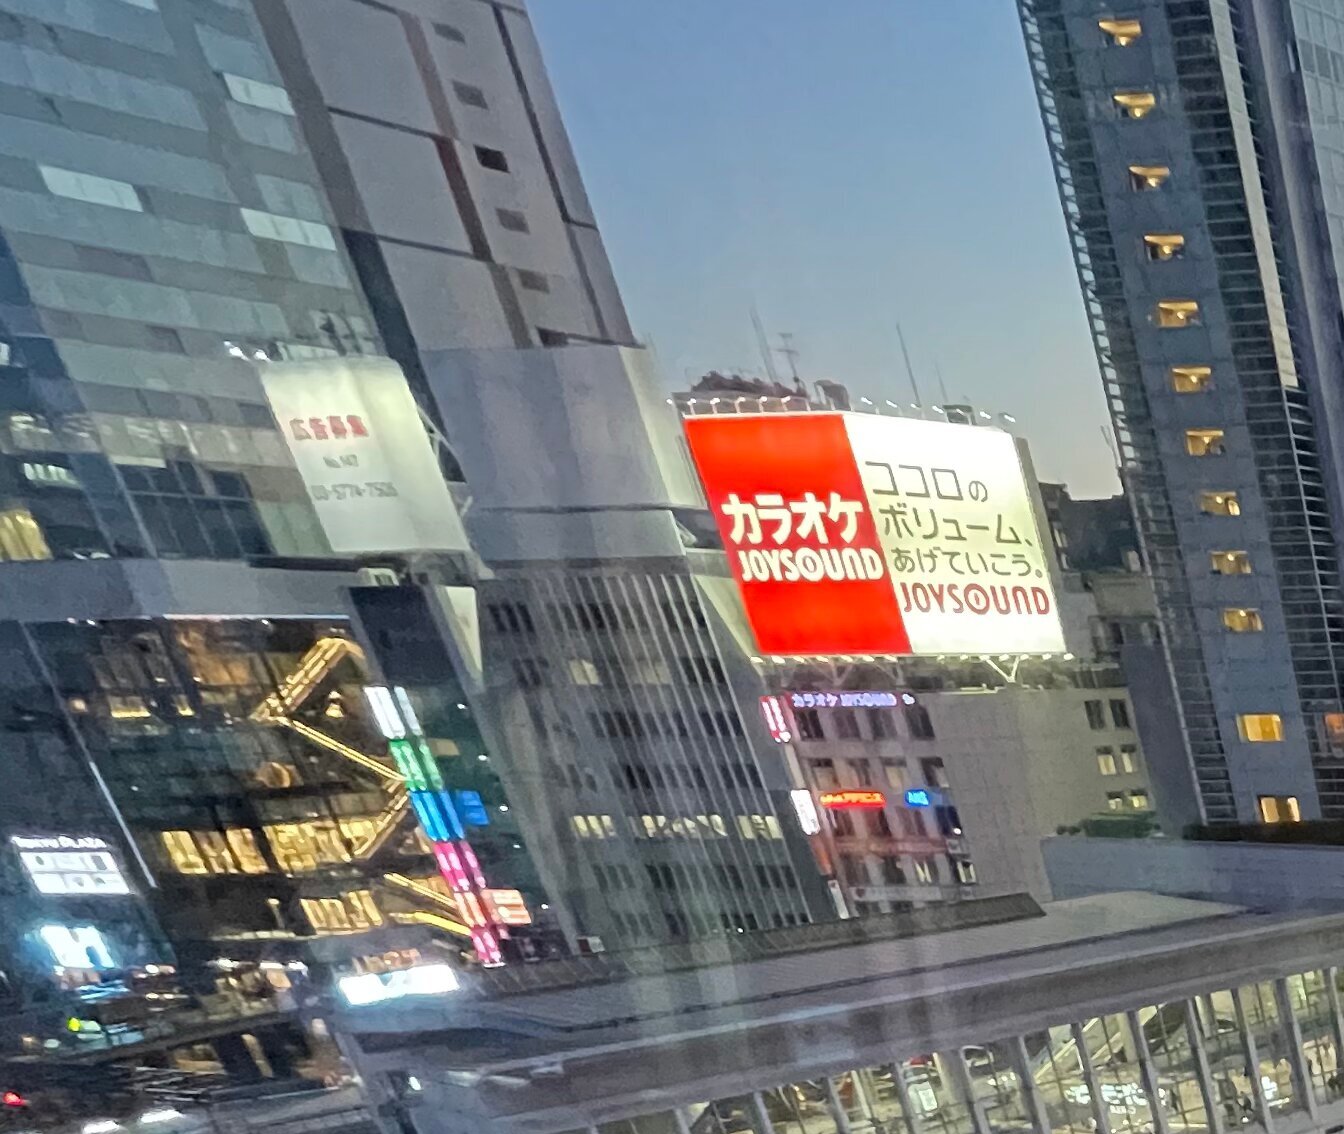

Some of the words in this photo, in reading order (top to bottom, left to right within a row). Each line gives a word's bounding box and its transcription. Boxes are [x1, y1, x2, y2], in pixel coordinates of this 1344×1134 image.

[865, 460, 988, 503] ココロの
[721, 490, 865, 544] カラオケ
[879, 502, 1034, 547] ボリューム、
[738, 546, 885, 583] JOYSOUND
[891, 546, 1044, 579] あげていこう。
[900, 581, 1051, 616] JOYSOUND
